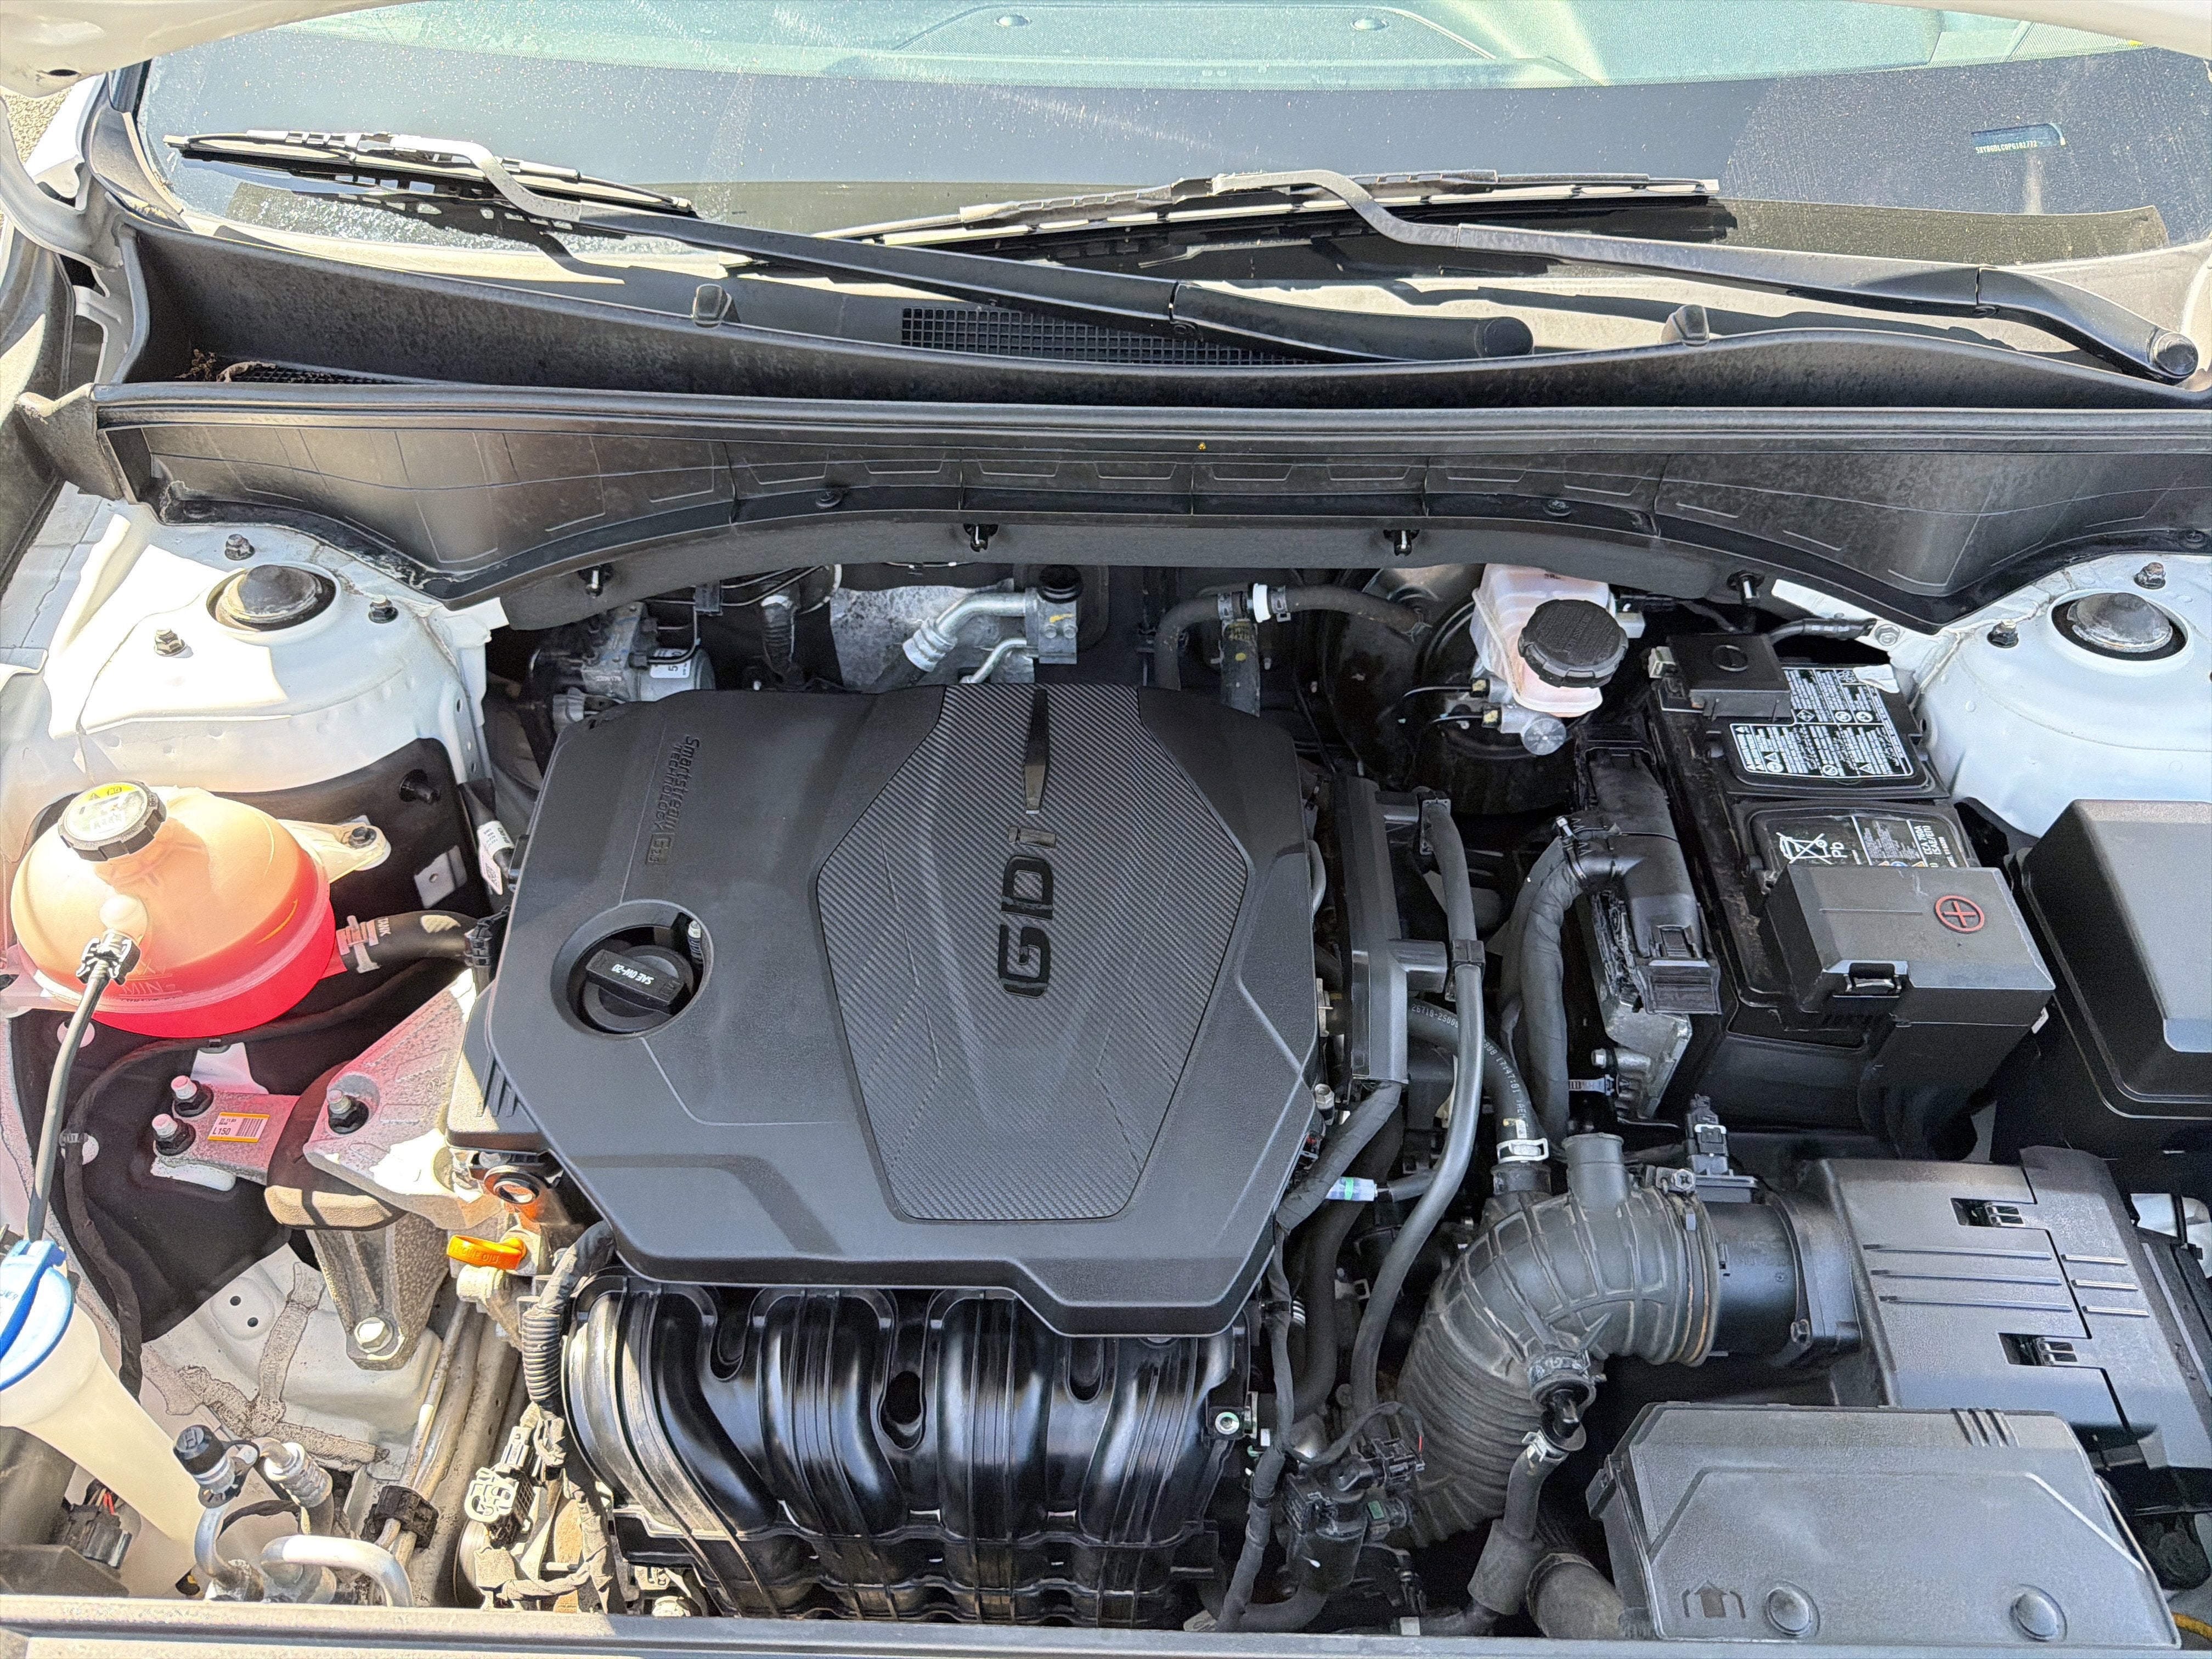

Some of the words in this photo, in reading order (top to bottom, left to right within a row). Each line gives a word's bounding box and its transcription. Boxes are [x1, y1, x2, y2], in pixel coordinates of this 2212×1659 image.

[1914, 825, 1927, 842] 760A
[1830, 842, 1847, 857] Pb
[1921, 842, 1933, 855] CCA
[377, 917, 392, 937] TANK
[611, 963, 638, 979] 0W-20
[635, 973, 654, 985] SAE
[123, 981, 163, 995] MIN
[212, 1127, 231, 1136] L150
[482, 1252, 499, 1264] OIL
